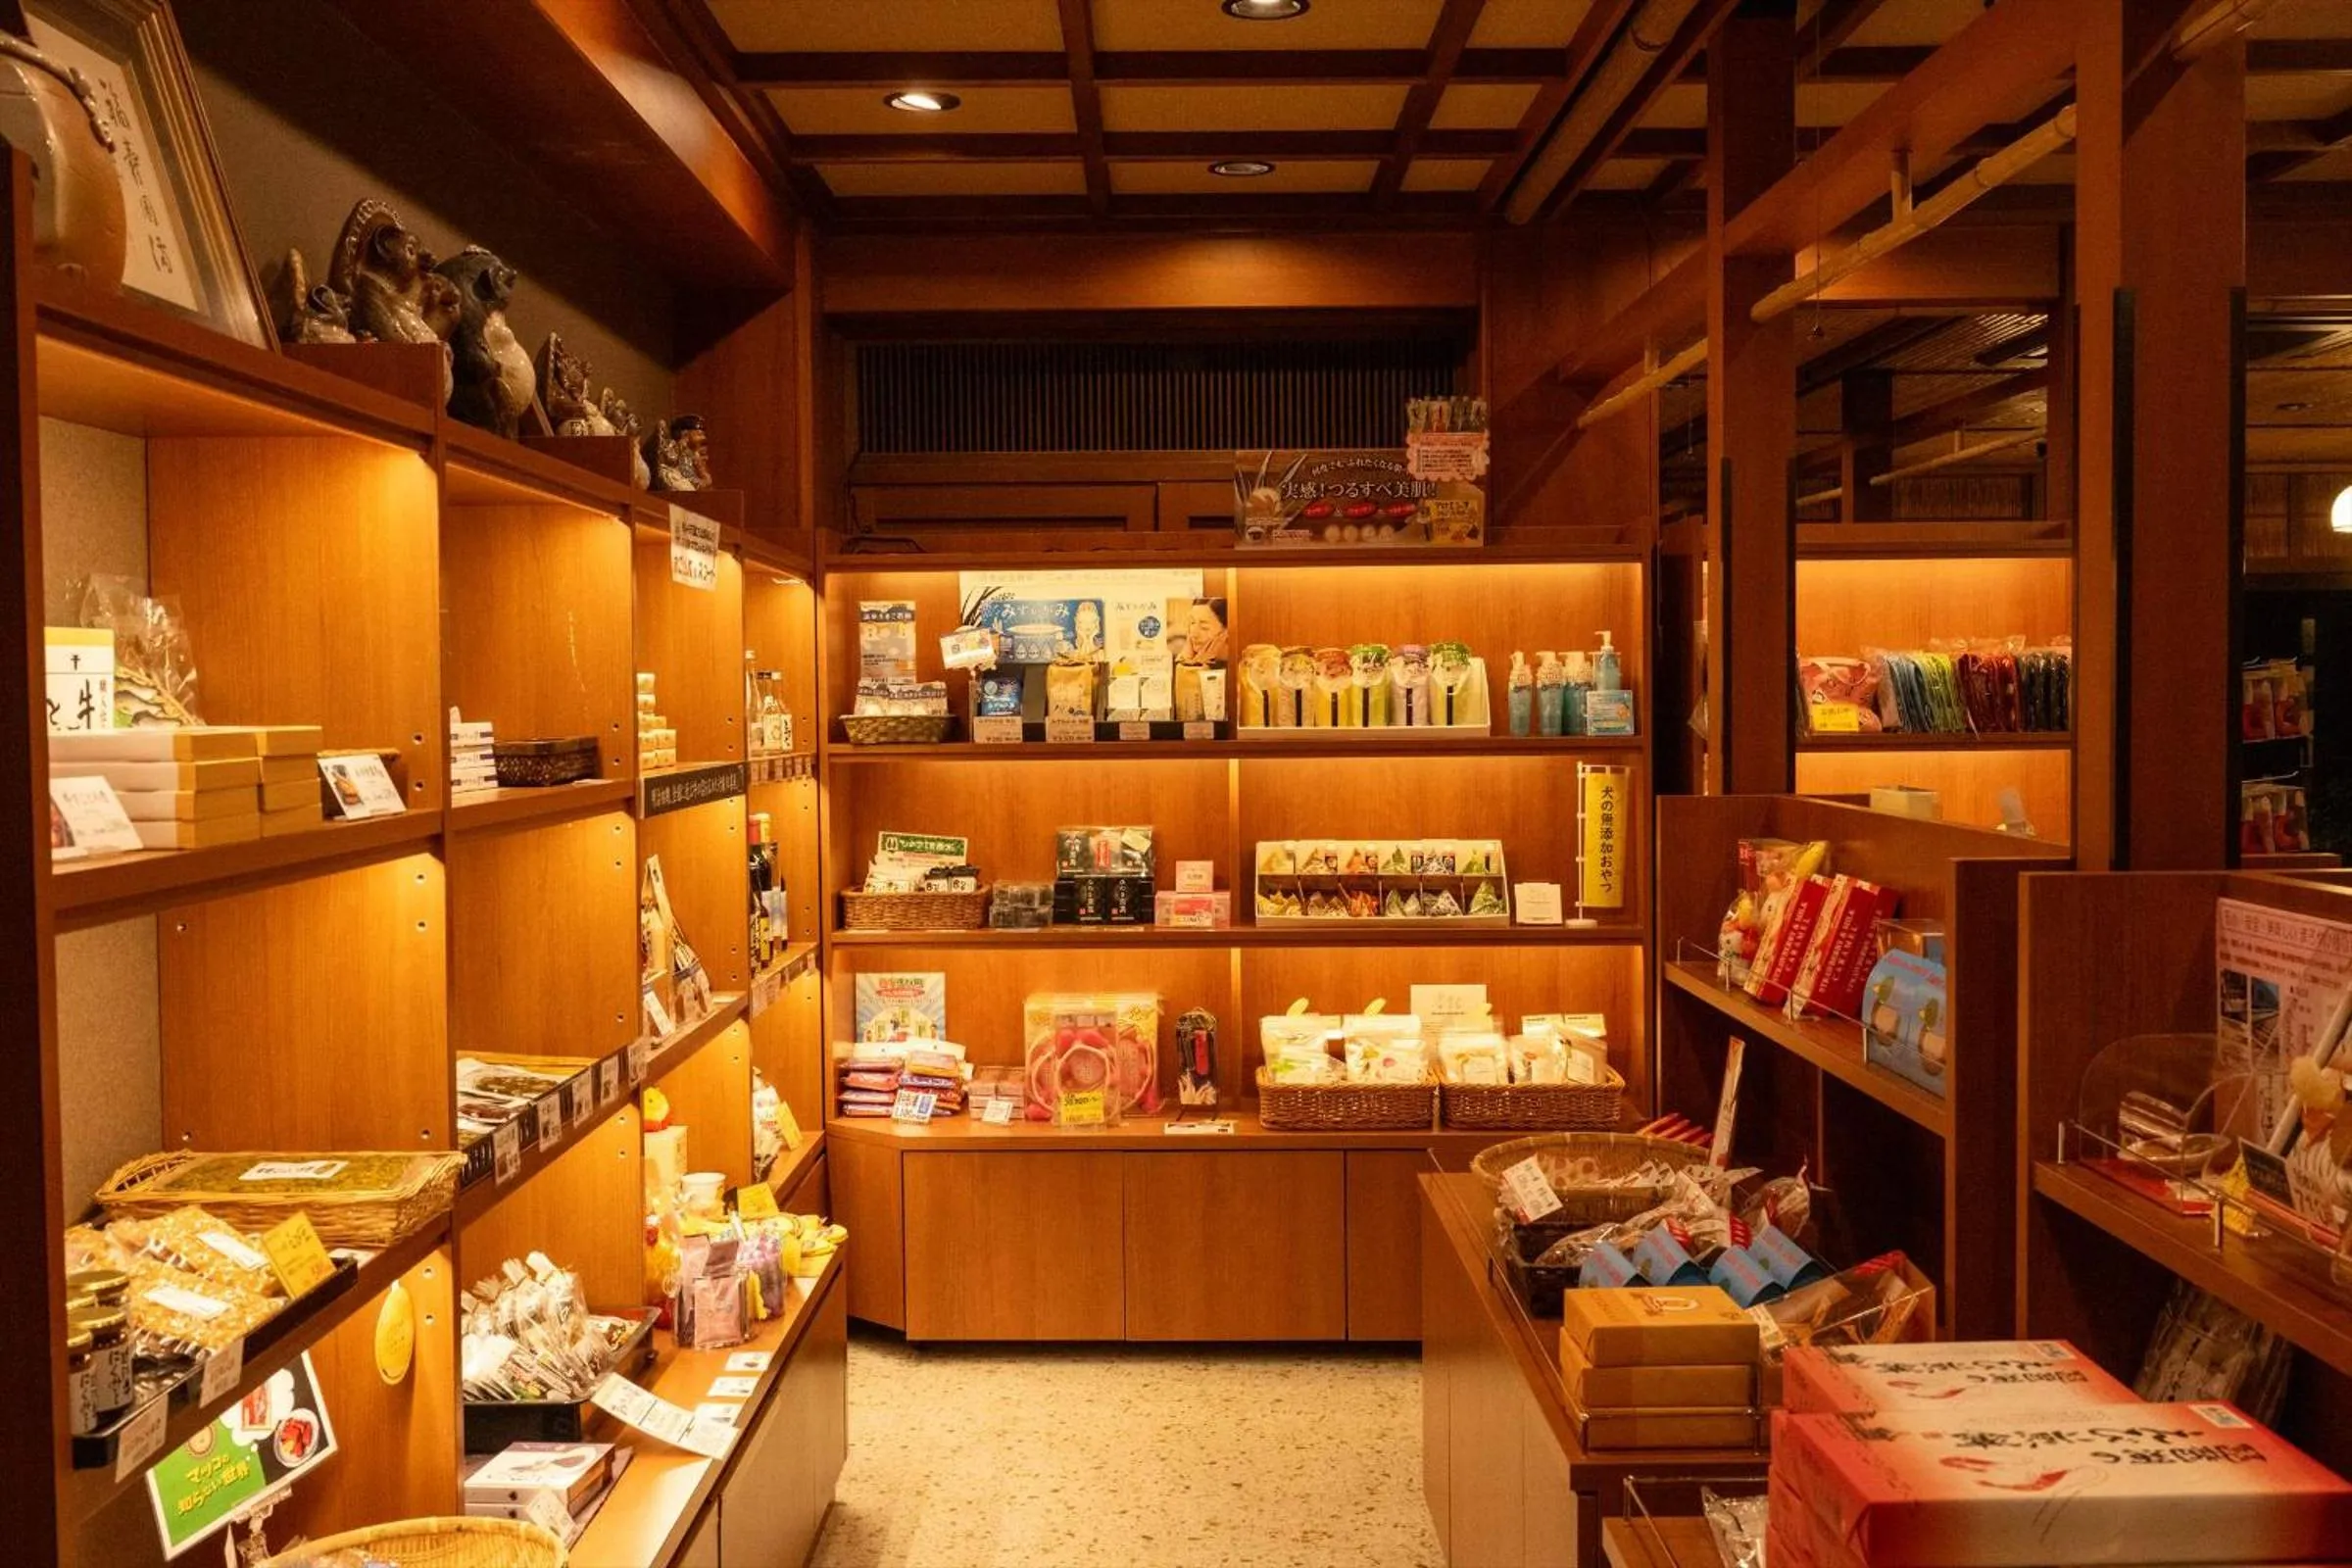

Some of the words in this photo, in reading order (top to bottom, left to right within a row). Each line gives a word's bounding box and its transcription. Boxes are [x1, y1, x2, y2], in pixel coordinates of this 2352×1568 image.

[1599, 785, 1614, 893] 犬の無添加おやつ
[1786, 918, 1811, 971] CARAMEL
